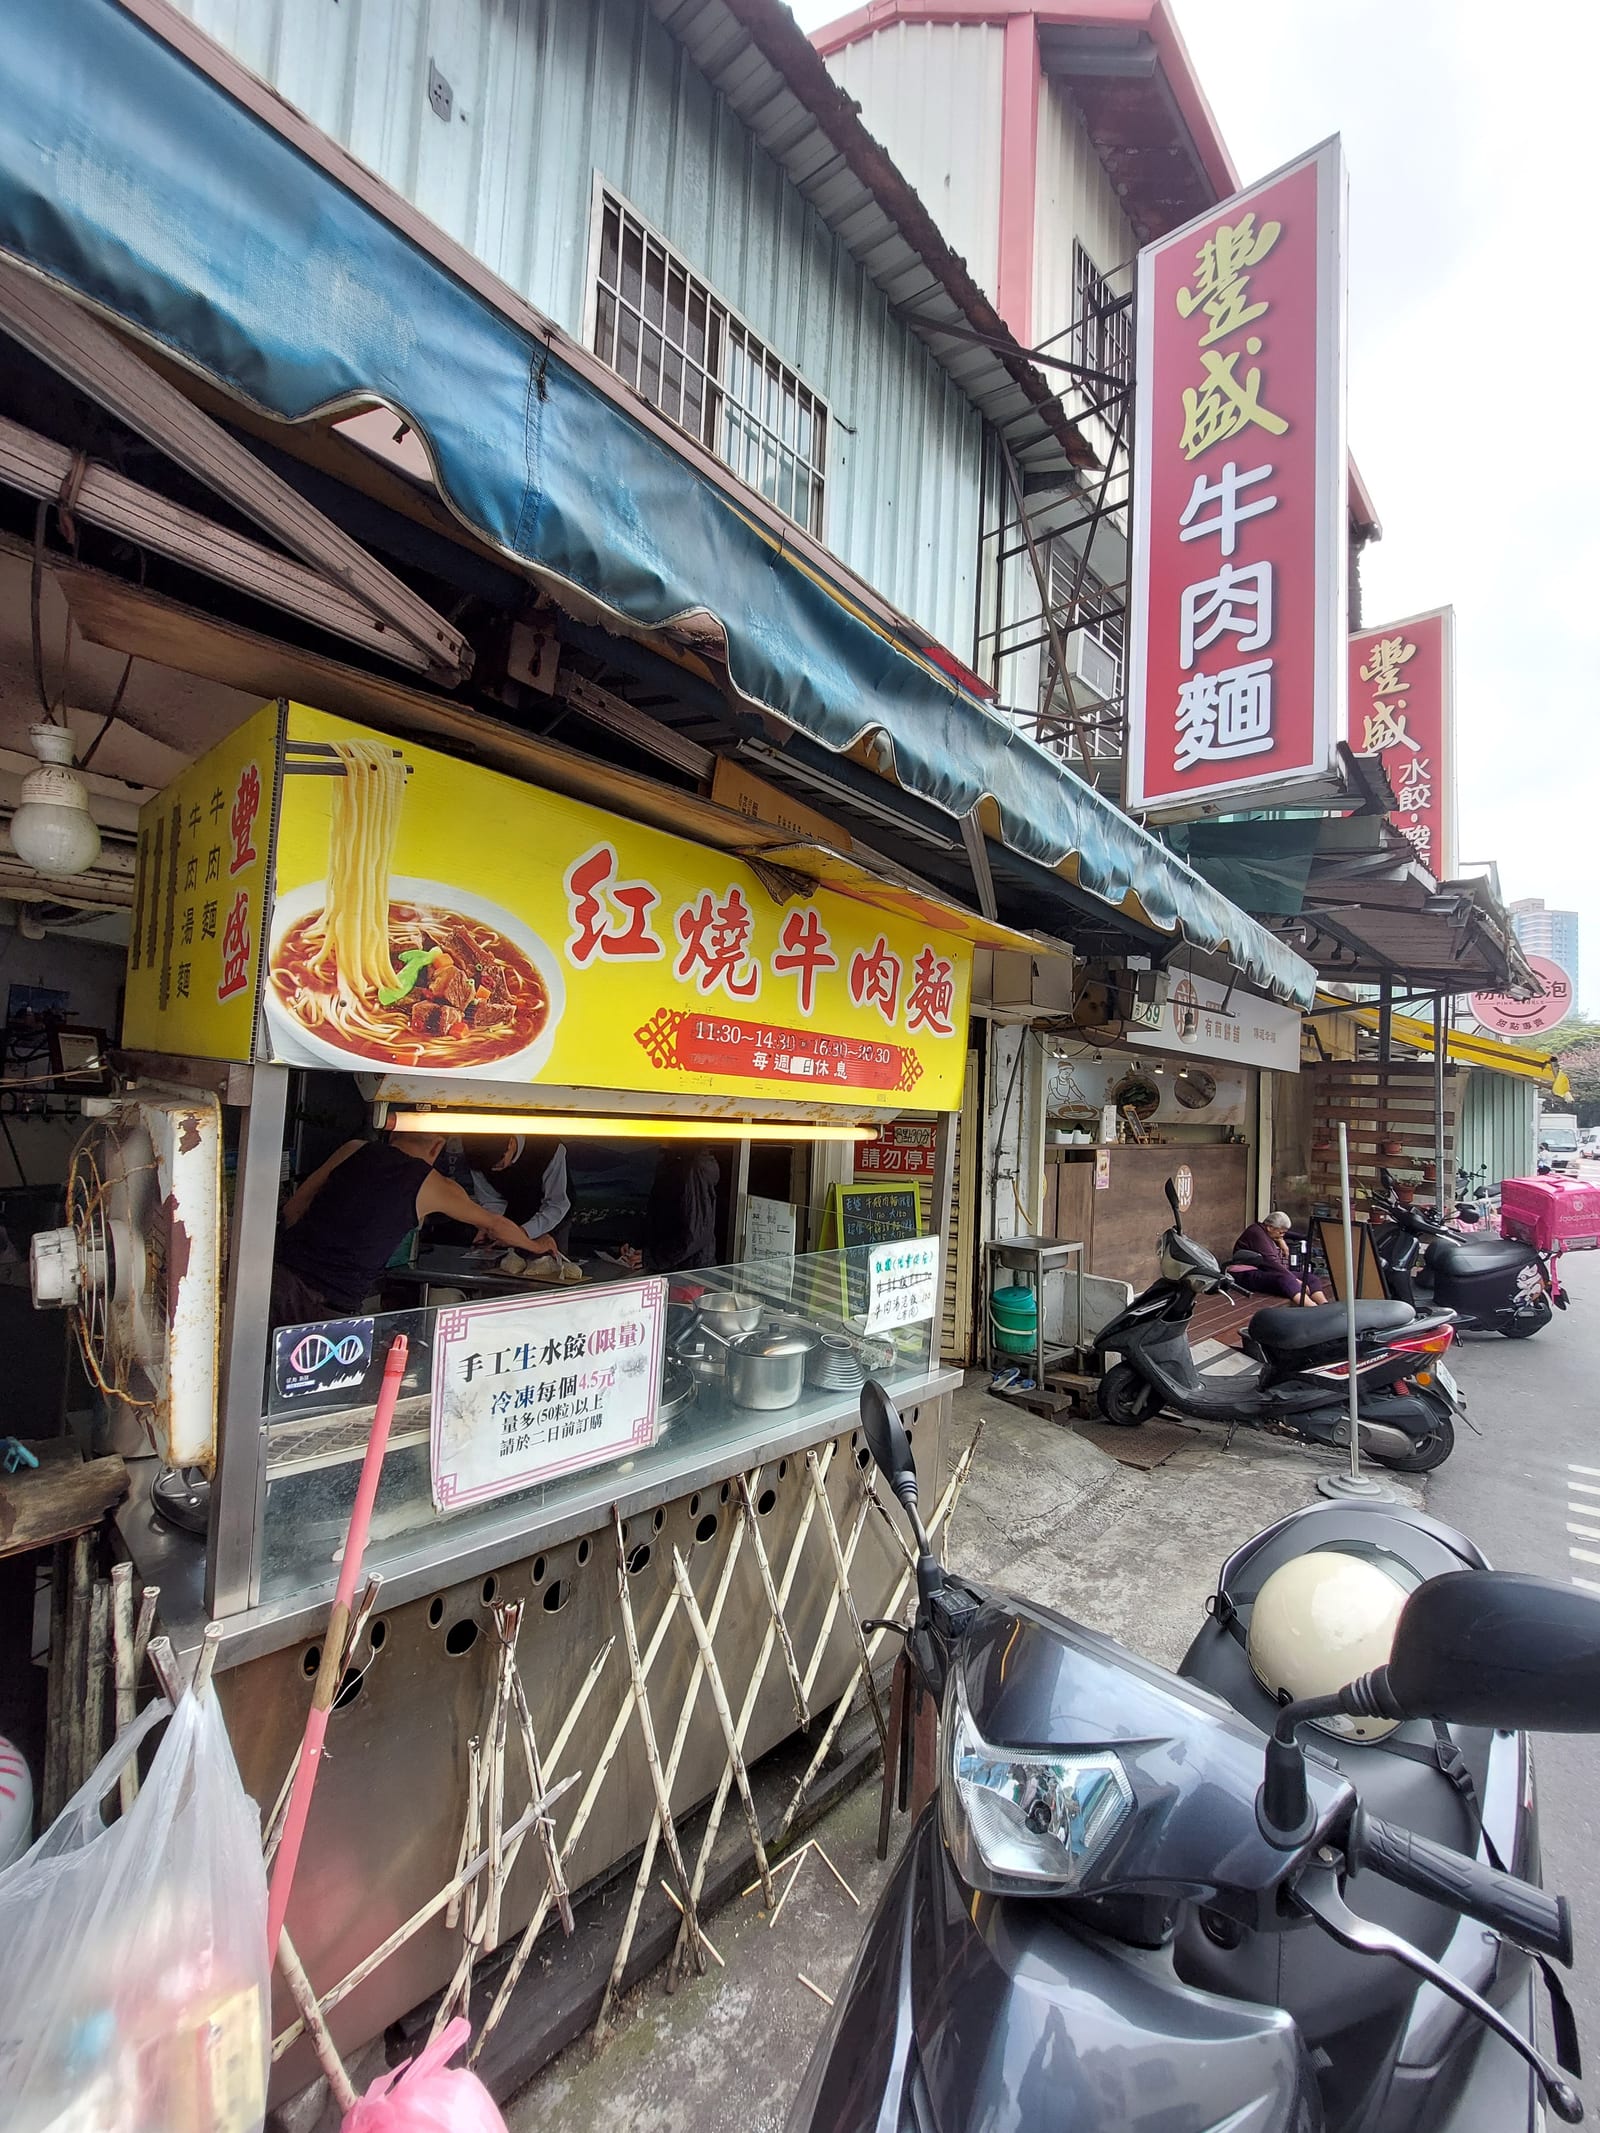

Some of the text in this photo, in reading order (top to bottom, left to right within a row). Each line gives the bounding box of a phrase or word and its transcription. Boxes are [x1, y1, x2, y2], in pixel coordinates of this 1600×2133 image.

[1360, 636, 1422, 757] 豐盛
[201, 786, 225, 942] 牛肉麵
[218, 763, 260, 1000] 豐盛
[569, 848, 953, 1035] 紅燒牛肉麵
[456, 1321, 646, 1383] 手工生水餃(限量)
[491, 1367, 616, 1416] 冷凍每個4.5元
[499, 1413, 603, 1458] 請於二日前訂購
[501, 1393, 604, 1436] 量多(50粒)以上
